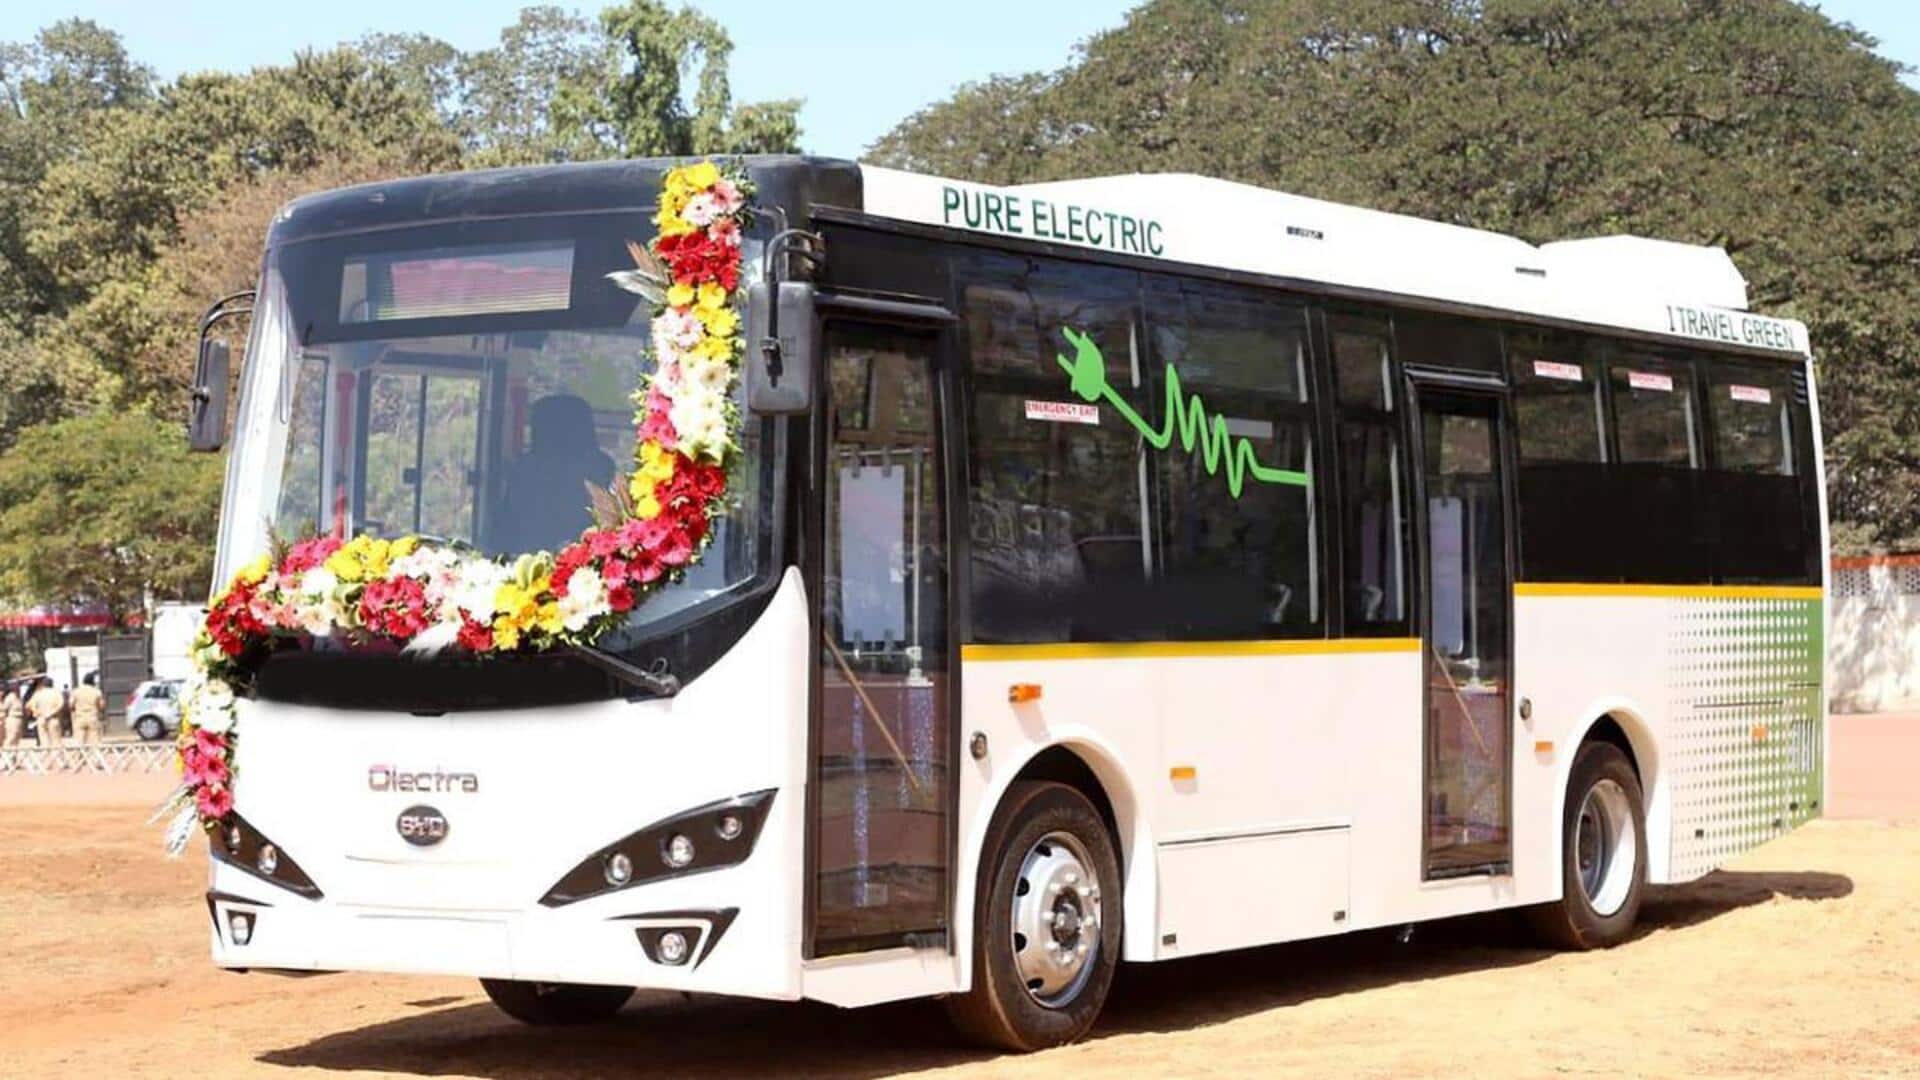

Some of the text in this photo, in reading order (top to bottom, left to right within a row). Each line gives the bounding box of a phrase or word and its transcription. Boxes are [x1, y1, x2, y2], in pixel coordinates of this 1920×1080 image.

[943, 186, 1164, 256] PURE ELECTRIC
[1666, 305, 1795, 348] I TRAVEL GREEN
[368, 764, 478, 792] Olectra
